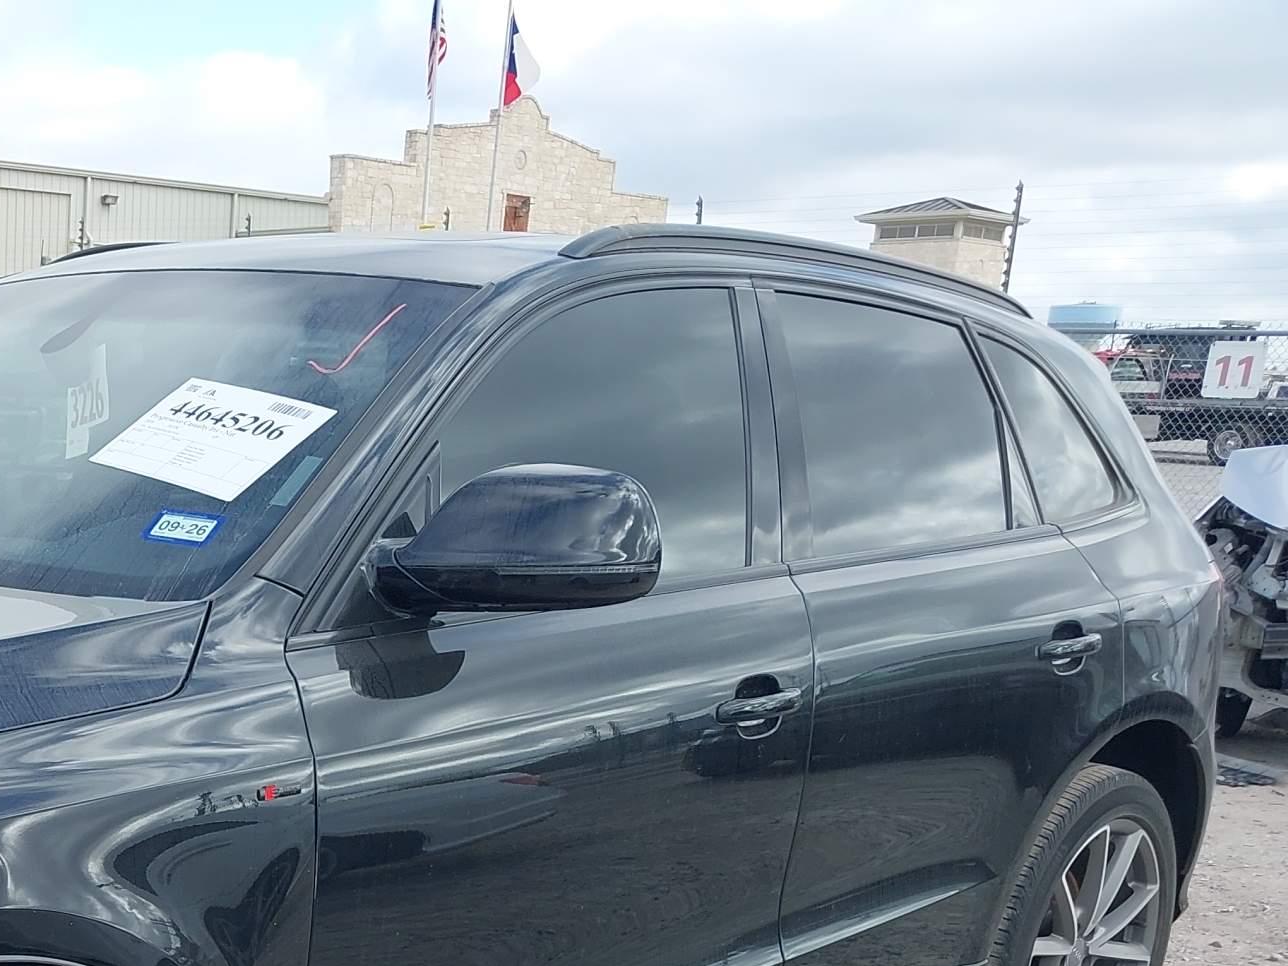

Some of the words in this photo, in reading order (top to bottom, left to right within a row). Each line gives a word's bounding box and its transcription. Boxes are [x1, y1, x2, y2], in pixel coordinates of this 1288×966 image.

[1215, 355, 1255, 388] 11
[169, 400, 292, 441] 44645206
[158, 520, 181, 532] 09
[185, 523, 209, 536] 26
